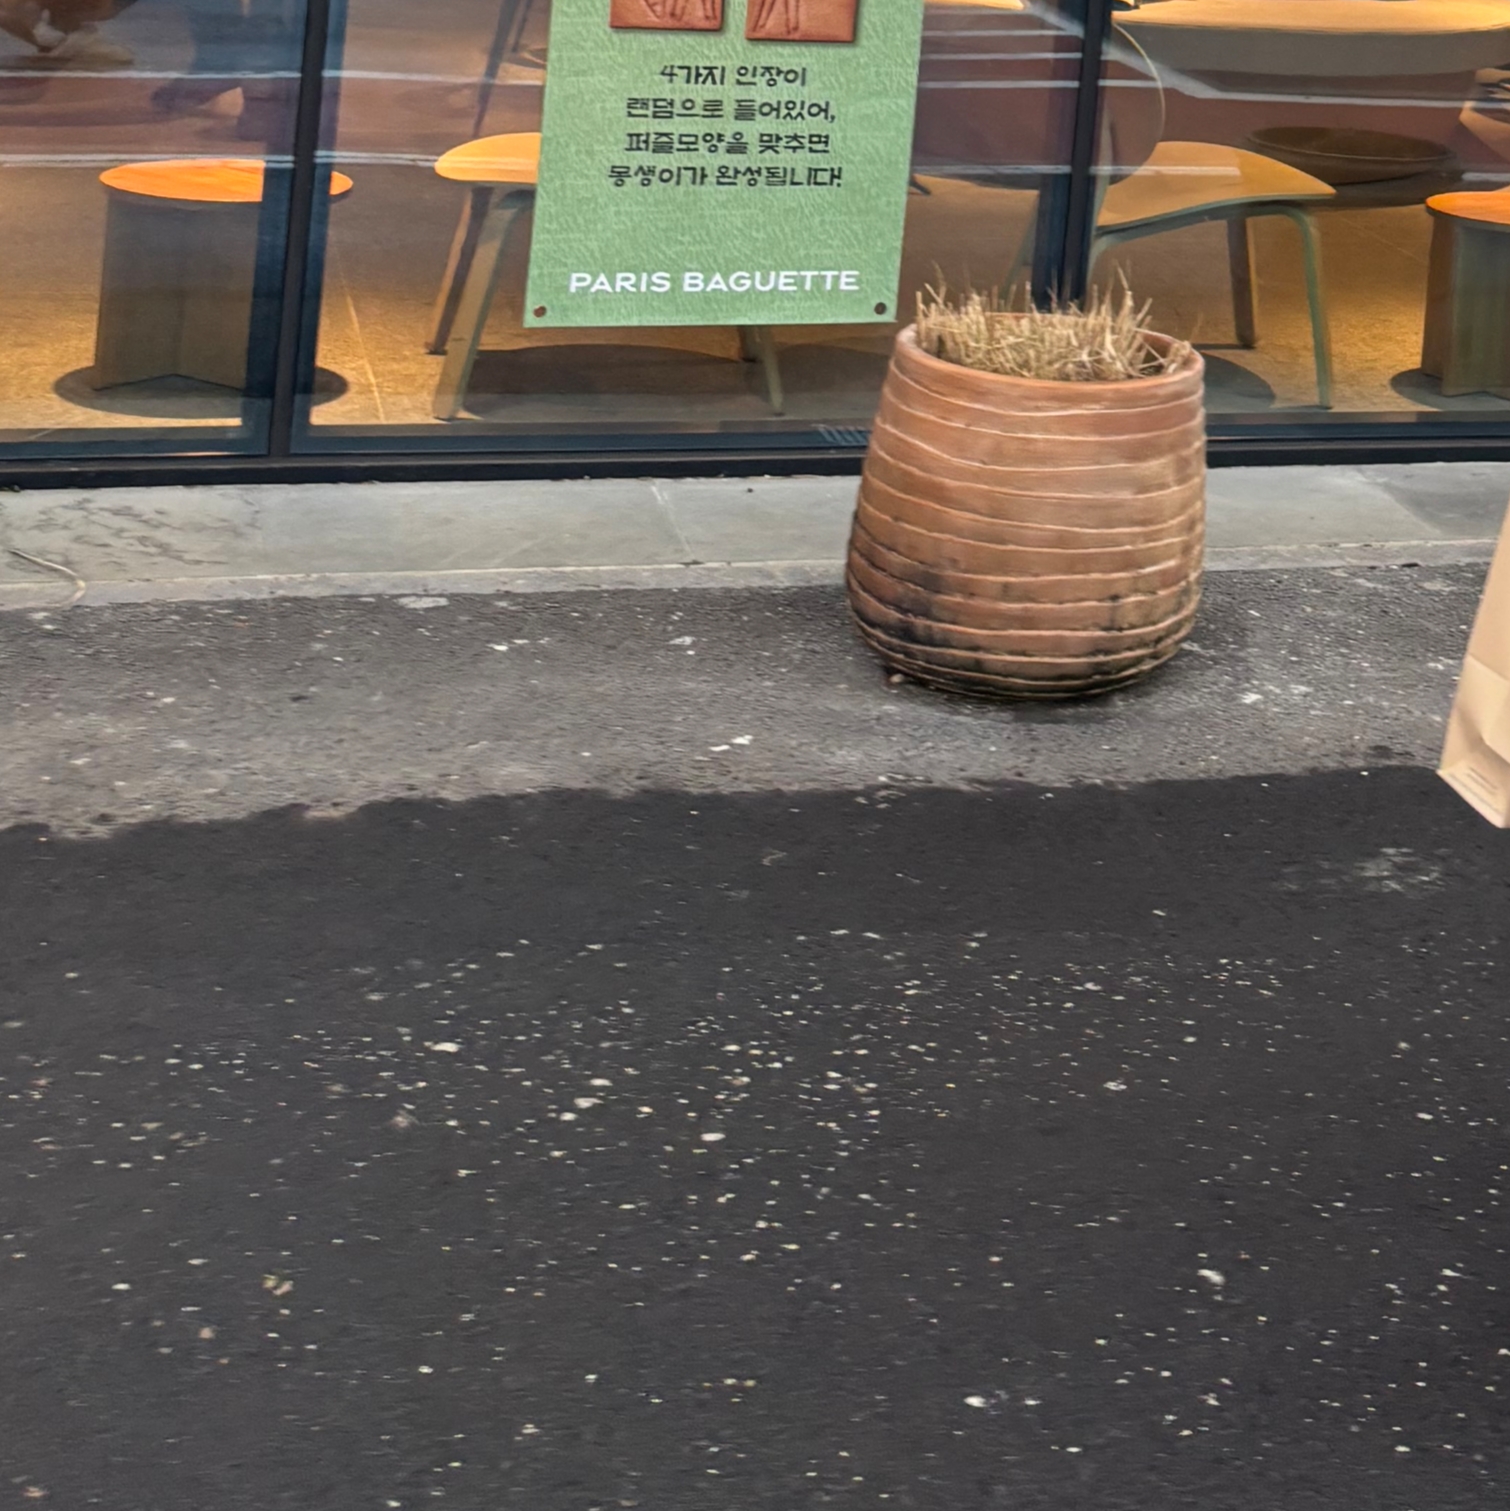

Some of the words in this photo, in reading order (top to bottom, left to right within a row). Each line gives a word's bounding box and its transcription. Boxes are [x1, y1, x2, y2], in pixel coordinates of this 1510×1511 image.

[660, 65, 725, 86] 4가지
[735, 65, 807, 87] 인장이
[626, 97, 724, 119] 랜덤으로
[734, 99, 836, 123] 들어있어,
[625, 131, 749, 154] 퍼즐모양을
[758, 132, 830, 154] 맞추면
[608, 165, 708, 187] 몽생이가
[569, 272, 671, 293] PARIS
[682, 270, 860, 292] BAGUETTE
